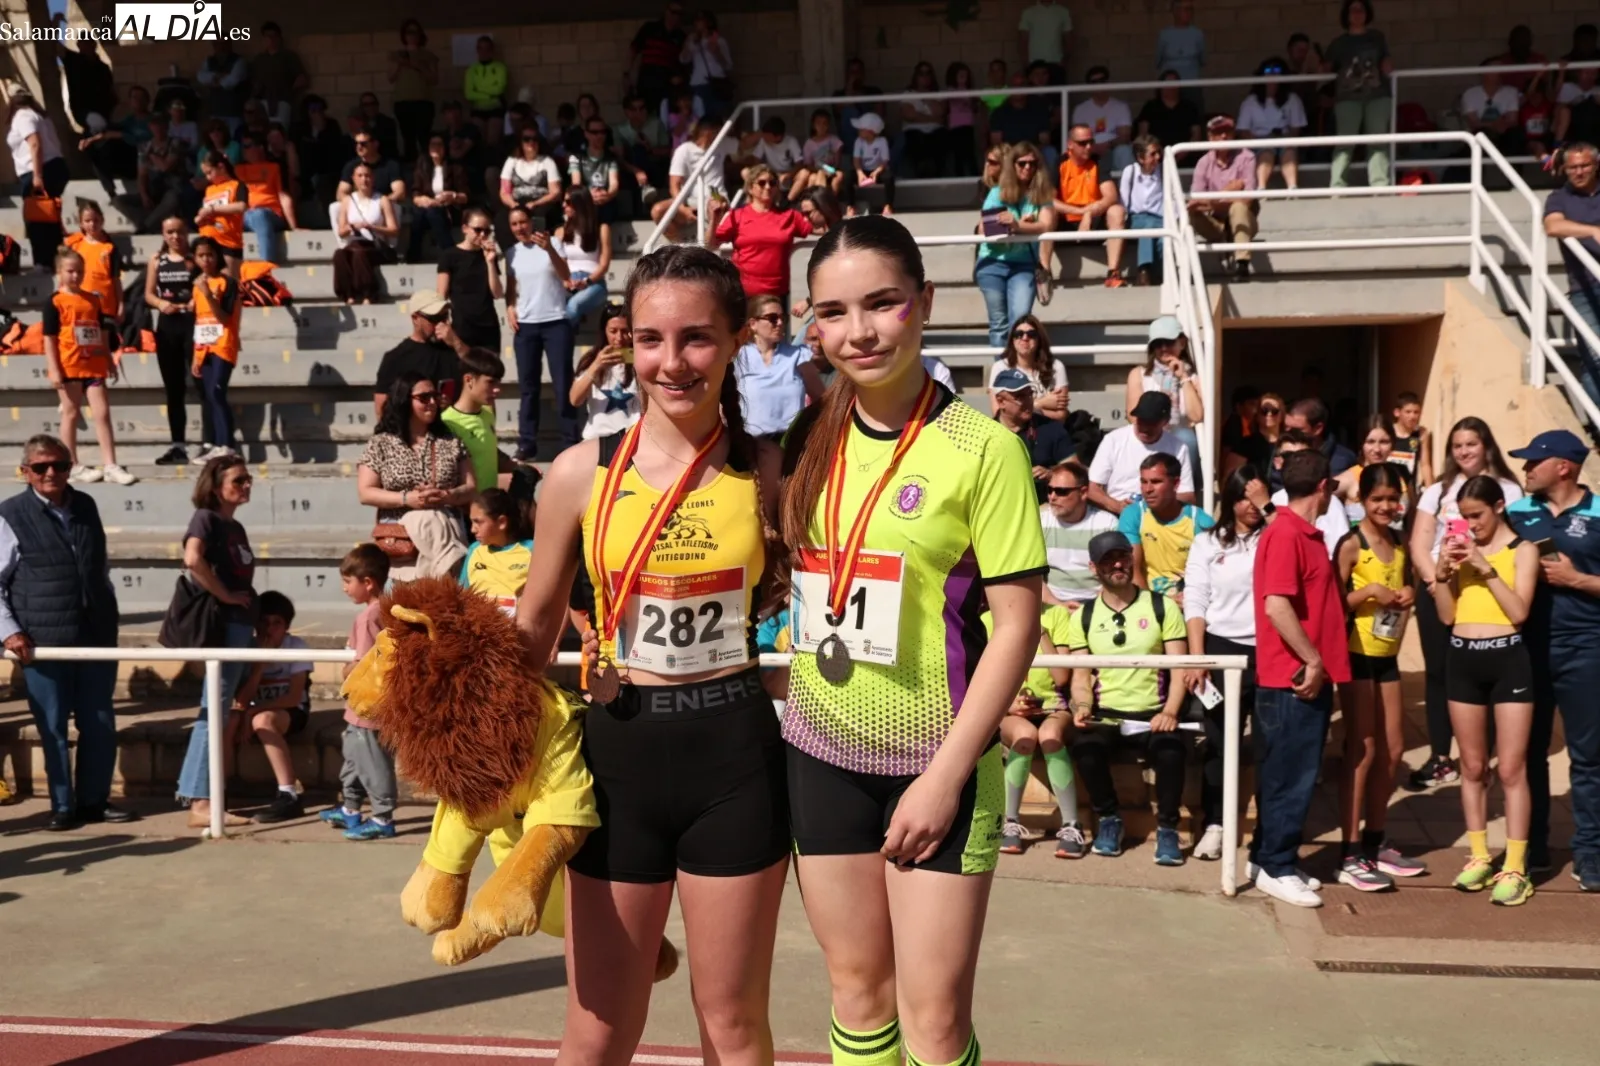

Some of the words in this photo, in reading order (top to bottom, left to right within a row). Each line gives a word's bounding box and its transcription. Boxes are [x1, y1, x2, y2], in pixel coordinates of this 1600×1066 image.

[291, 499, 310, 511] 19
[686, 499, 715, 509] LEONES
[651, 541, 673, 552] UTSAL
[681, 540, 719, 551] ATLETISMO
[656, 552, 706, 562] VITIGUDINO
[857, 556, 880, 565] LARES
[122, 575, 142, 587] 21
[304, 575, 326, 587] 17
[670, 574, 717, 586] ESCOLARES
[642, 601, 725, 647] 282
[1468, 637, 1508, 650] NIKE
